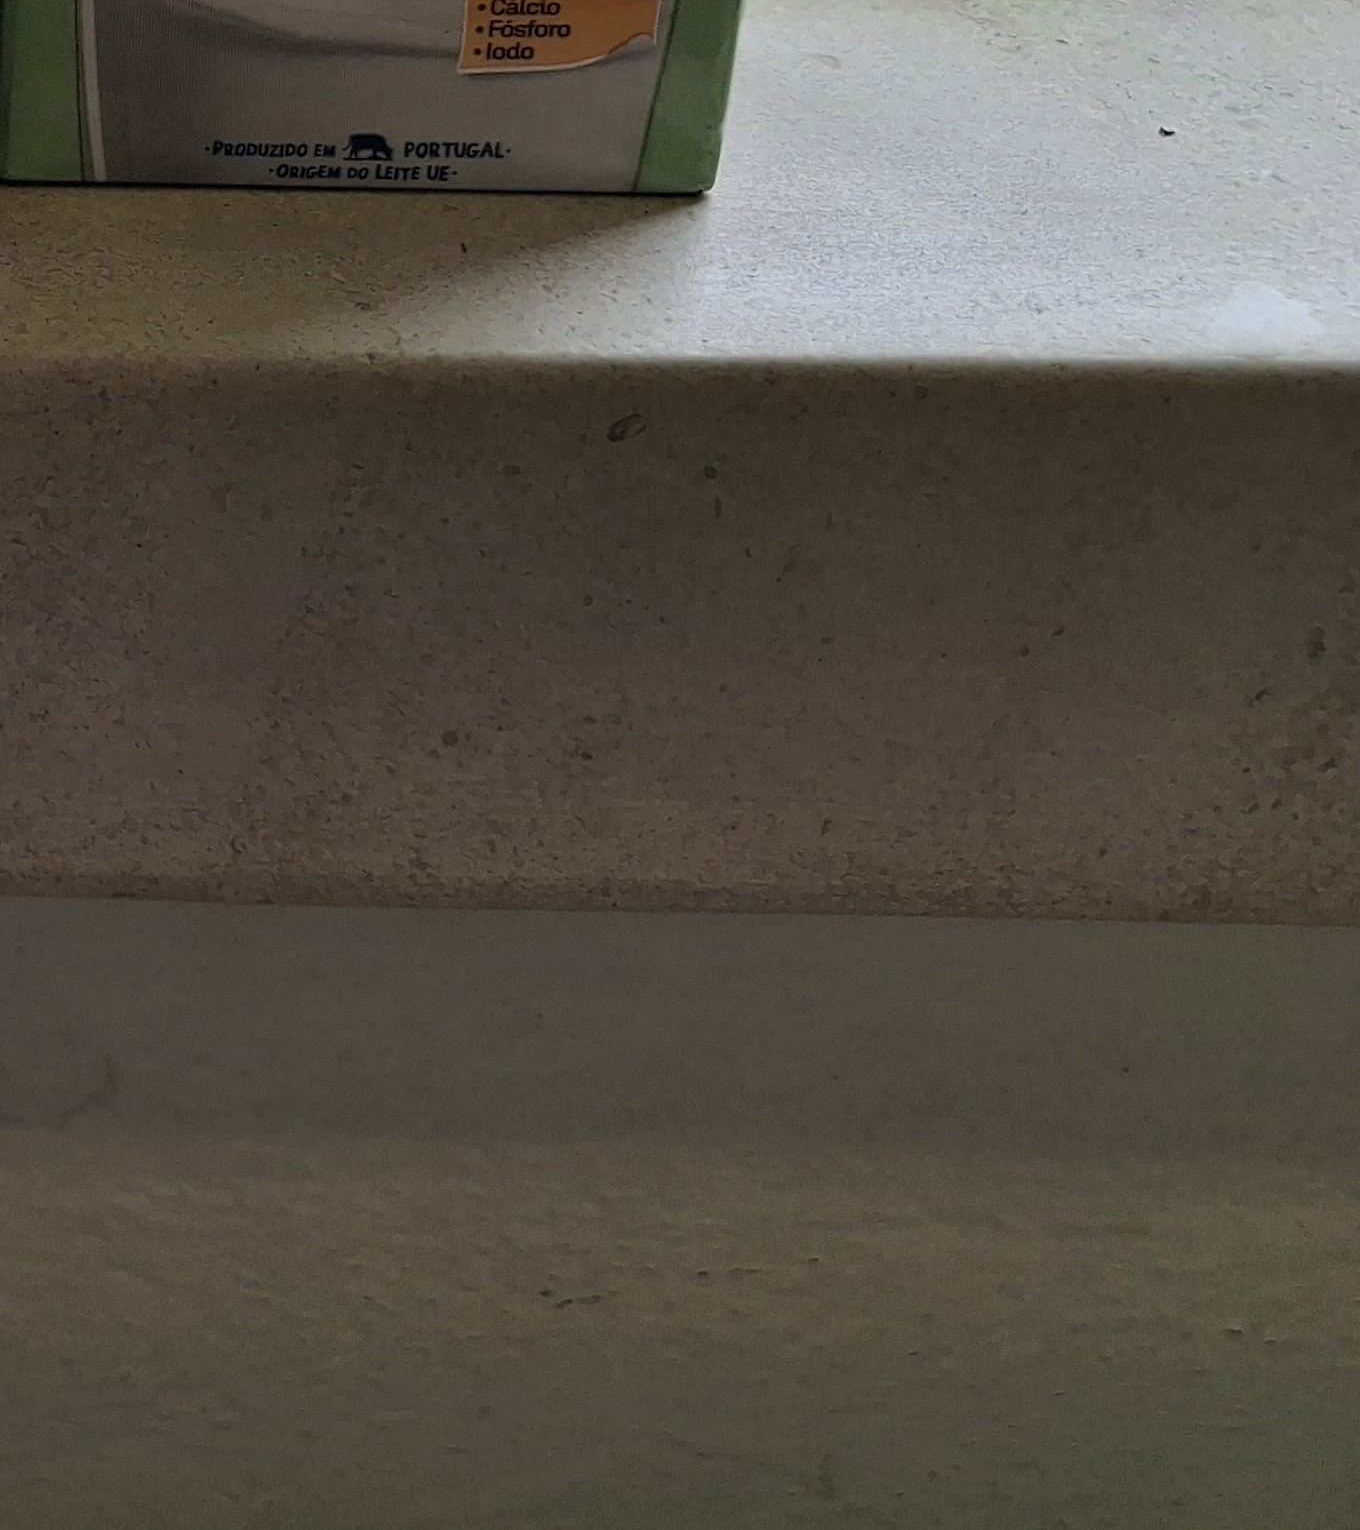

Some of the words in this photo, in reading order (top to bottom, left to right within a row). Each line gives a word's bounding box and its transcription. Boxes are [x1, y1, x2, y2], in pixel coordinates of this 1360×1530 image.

[488, 19, 570, 37] Fósforo
[486, 41, 534, 59] Iodo
[314, 144, 336, 157] EM
[347, 165, 368, 180] DO
